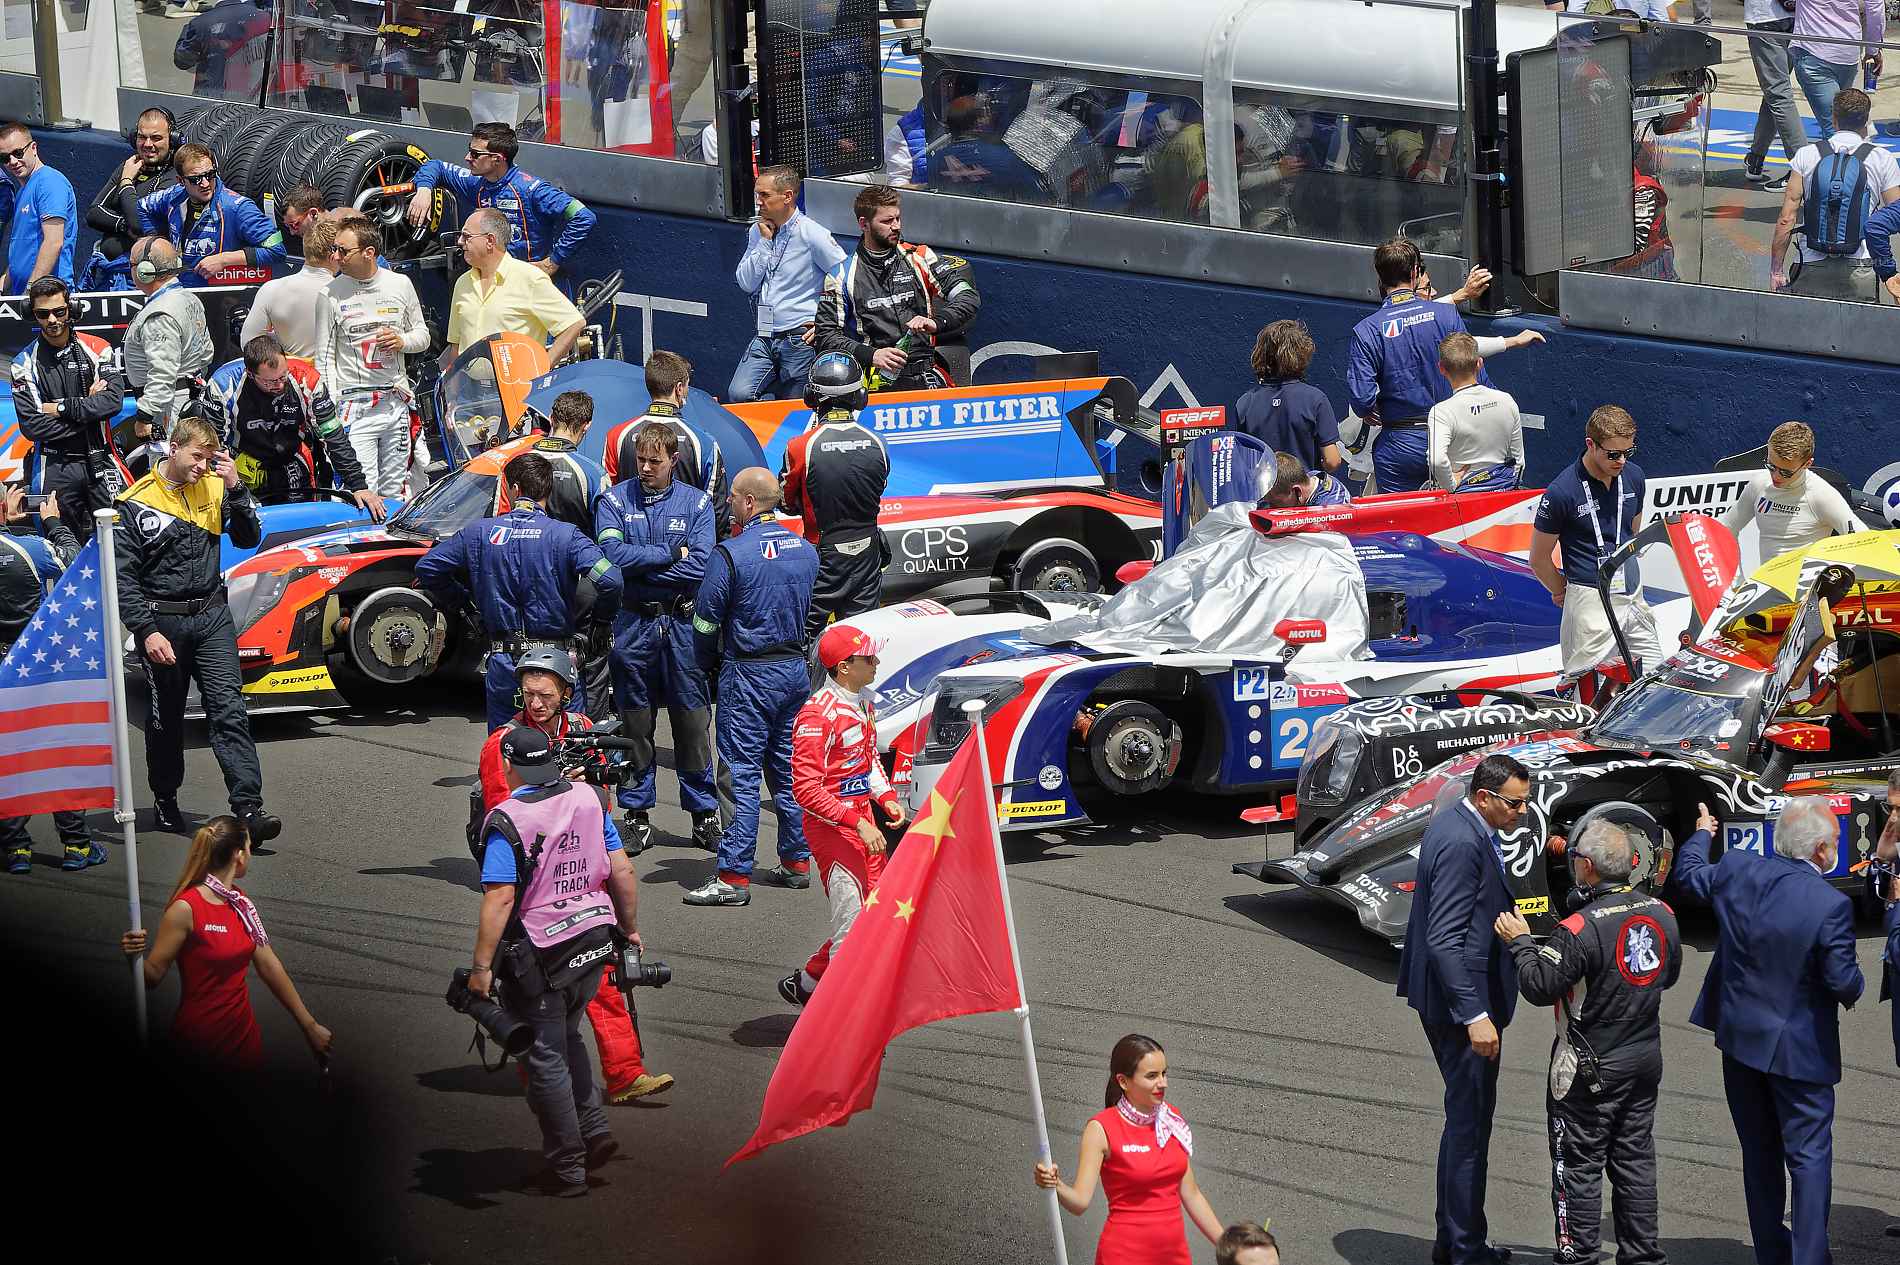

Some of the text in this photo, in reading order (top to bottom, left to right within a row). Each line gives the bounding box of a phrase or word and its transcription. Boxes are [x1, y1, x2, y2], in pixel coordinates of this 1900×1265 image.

[867, 290, 915, 309] GRAFF
[1403, 312, 1435, 323] UNITED
[873, 396, 1060, 431] HIFI FILTER
[1165, 411, 1221, 425] GRAFF
[820, 440, 872, 453] GRAFF
[1772, 503, 1801, 512] UNITED
[1276, 513, 1353, 528] unitedautosports.com
[901, 526, 969, 559] CPS
[903, 557, 969, 573] QUALITY
[1830, 608, 1893, 626] TAL
[1288, 630, 1323, 639] MOTUL
[280, 672, 328, 685] DUNLOP
[1238, 670, 1265, 696] P2
[1302, 687, 1346, 698] TOTAL
[1437, 735, 1485, 749] RICHARD
[1011, 803, 1062, 814] DUNLOP
[1728, 828, 1759, 850] P2
[553, 857, 588, 879] MEDIA
[554, 875, 590, 895] TRACK
[1356, 873, 1390, 902] TOTAL
[204, 923, 228, 933] MOTUL
